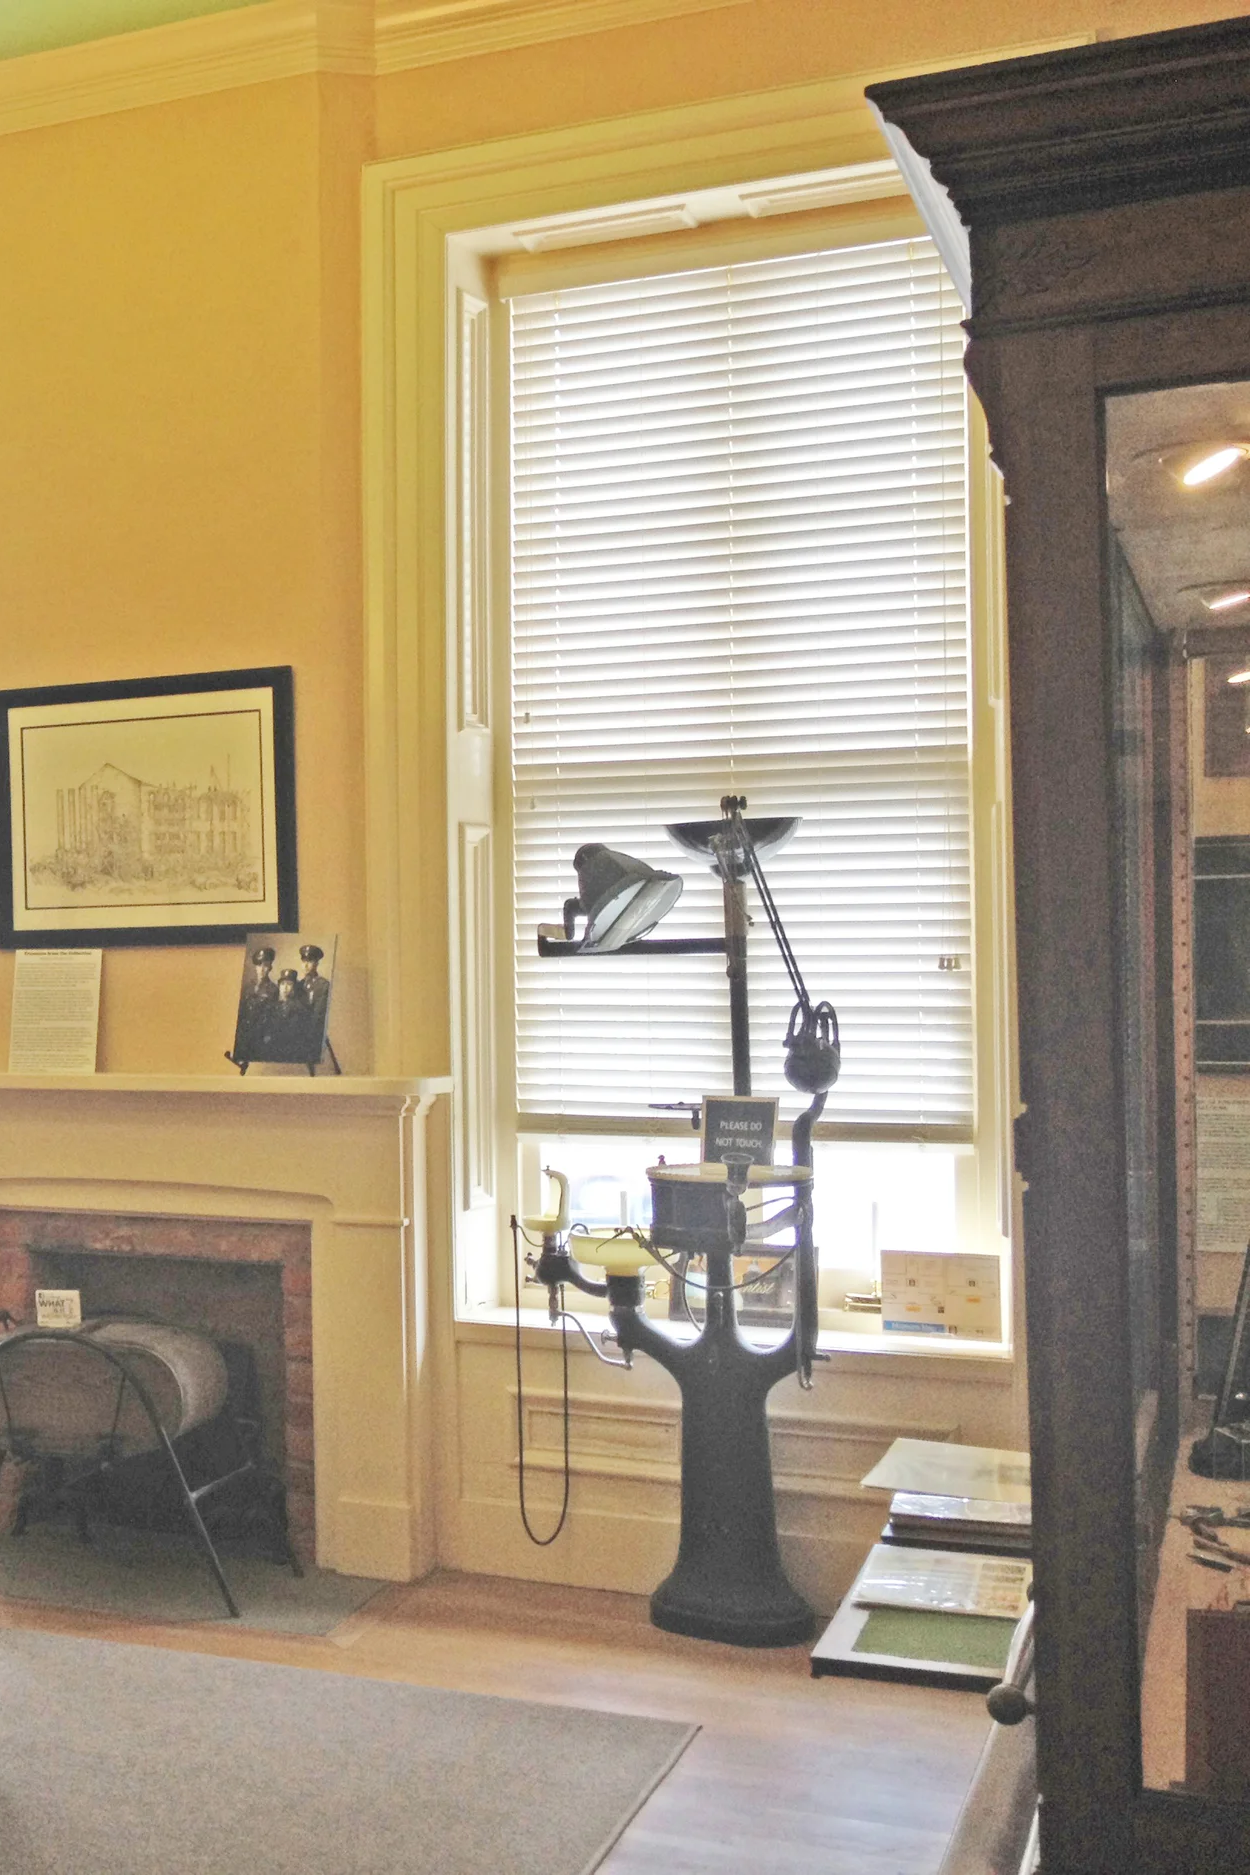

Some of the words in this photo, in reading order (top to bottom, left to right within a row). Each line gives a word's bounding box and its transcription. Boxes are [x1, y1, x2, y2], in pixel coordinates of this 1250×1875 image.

[720, 1121, 748, 1131] PLEASE
[750, 1121, 762, 1131] DO
[715, 1137, 732, 1147] NOT
